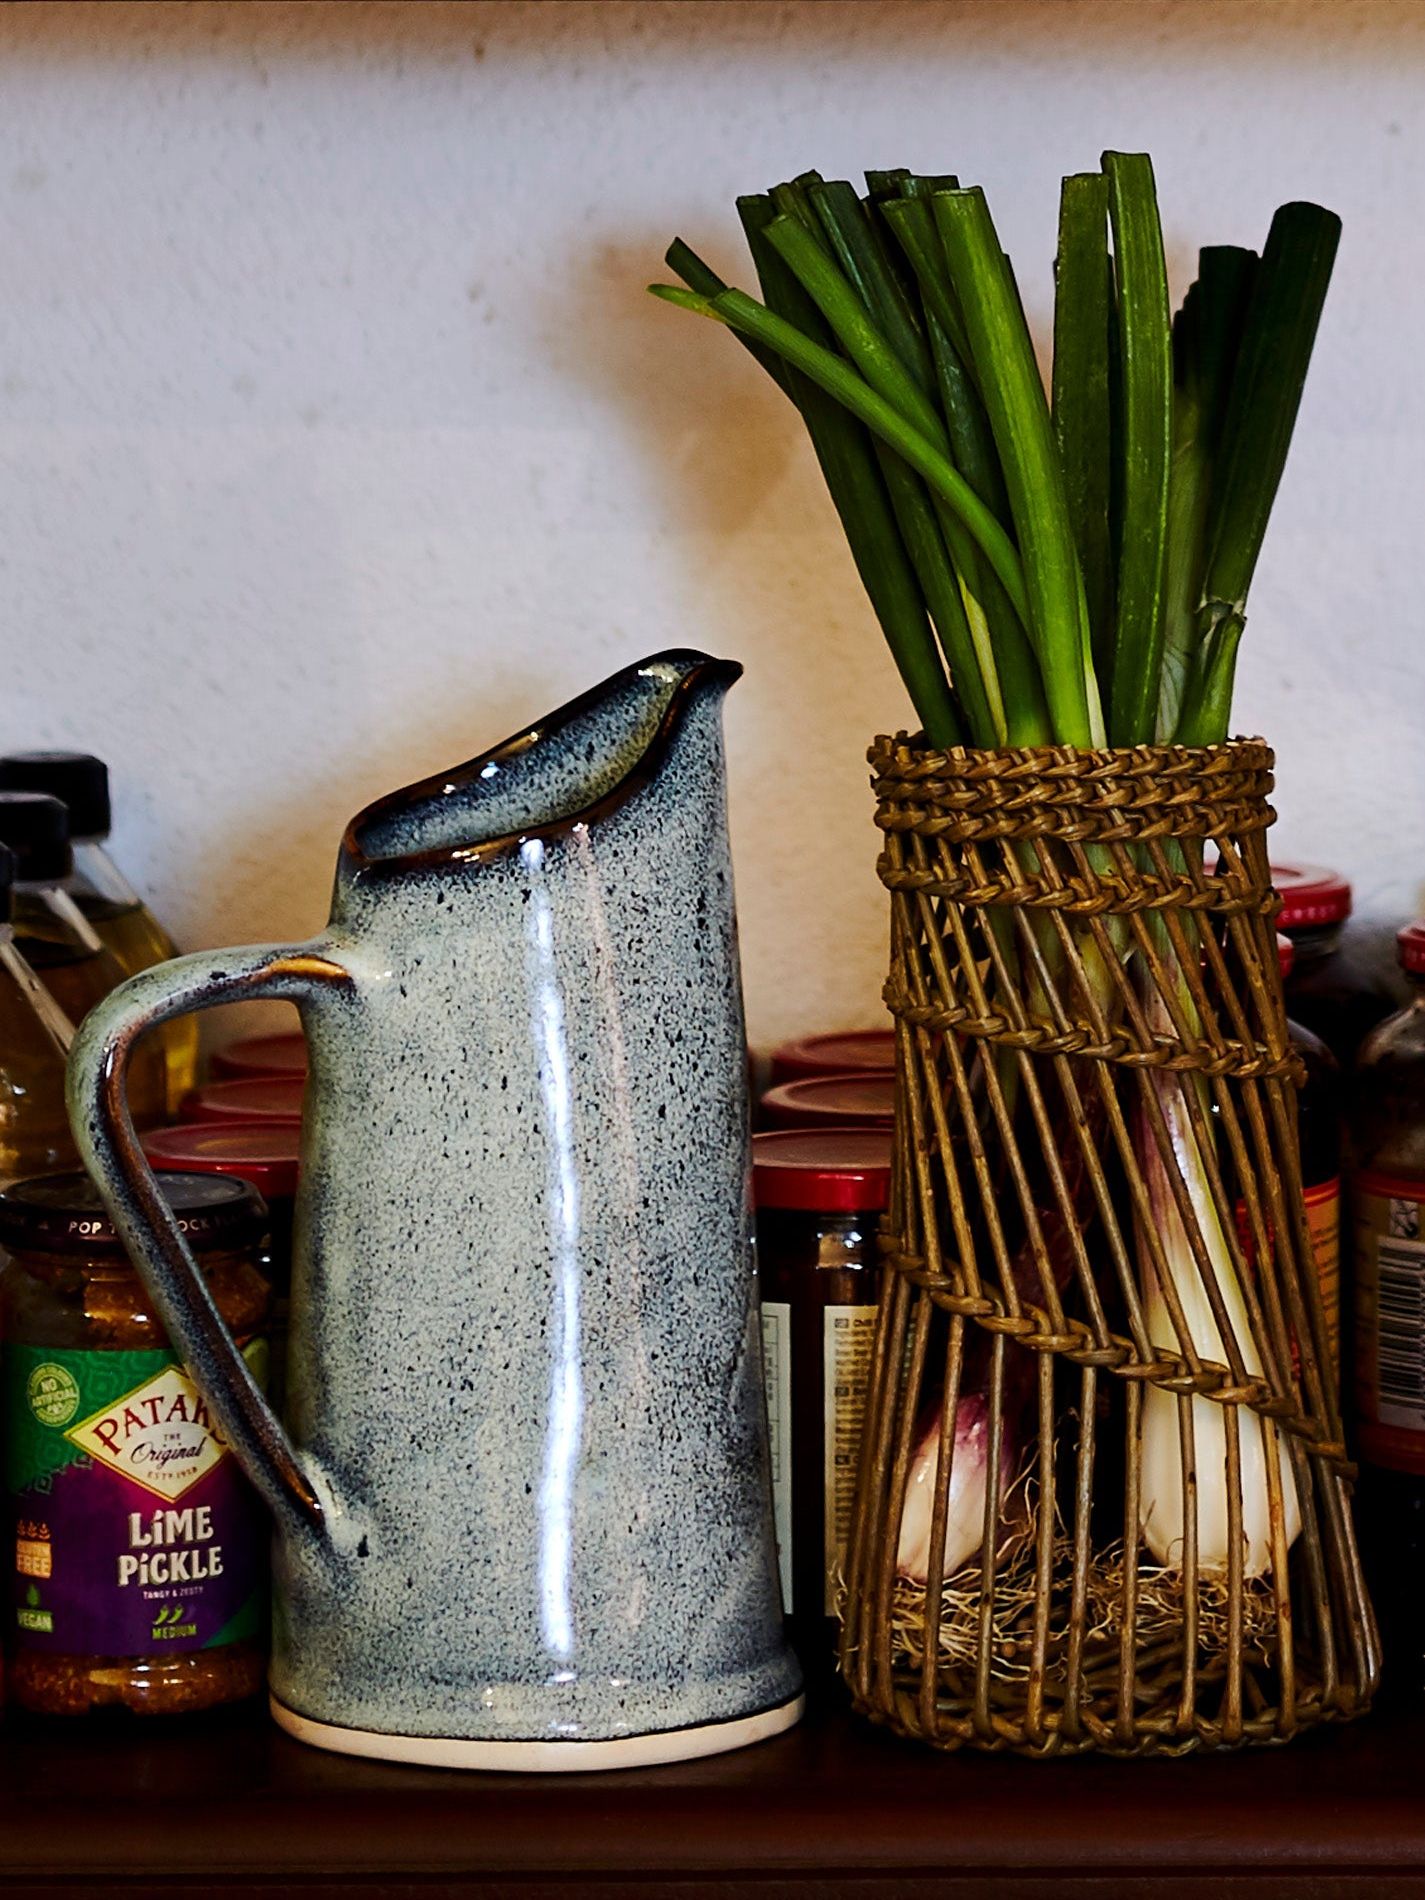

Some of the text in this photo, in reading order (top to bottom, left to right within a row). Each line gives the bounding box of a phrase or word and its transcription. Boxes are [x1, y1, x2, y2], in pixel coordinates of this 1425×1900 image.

[68, 1220, 102, 1234] POP
[41, 1378, 57, 1393] NO
[164, 1433, 181, 1441] THE
[131, 1437, 207, 1470] Original
[18, 1611, 52, 1631] VEGAN
